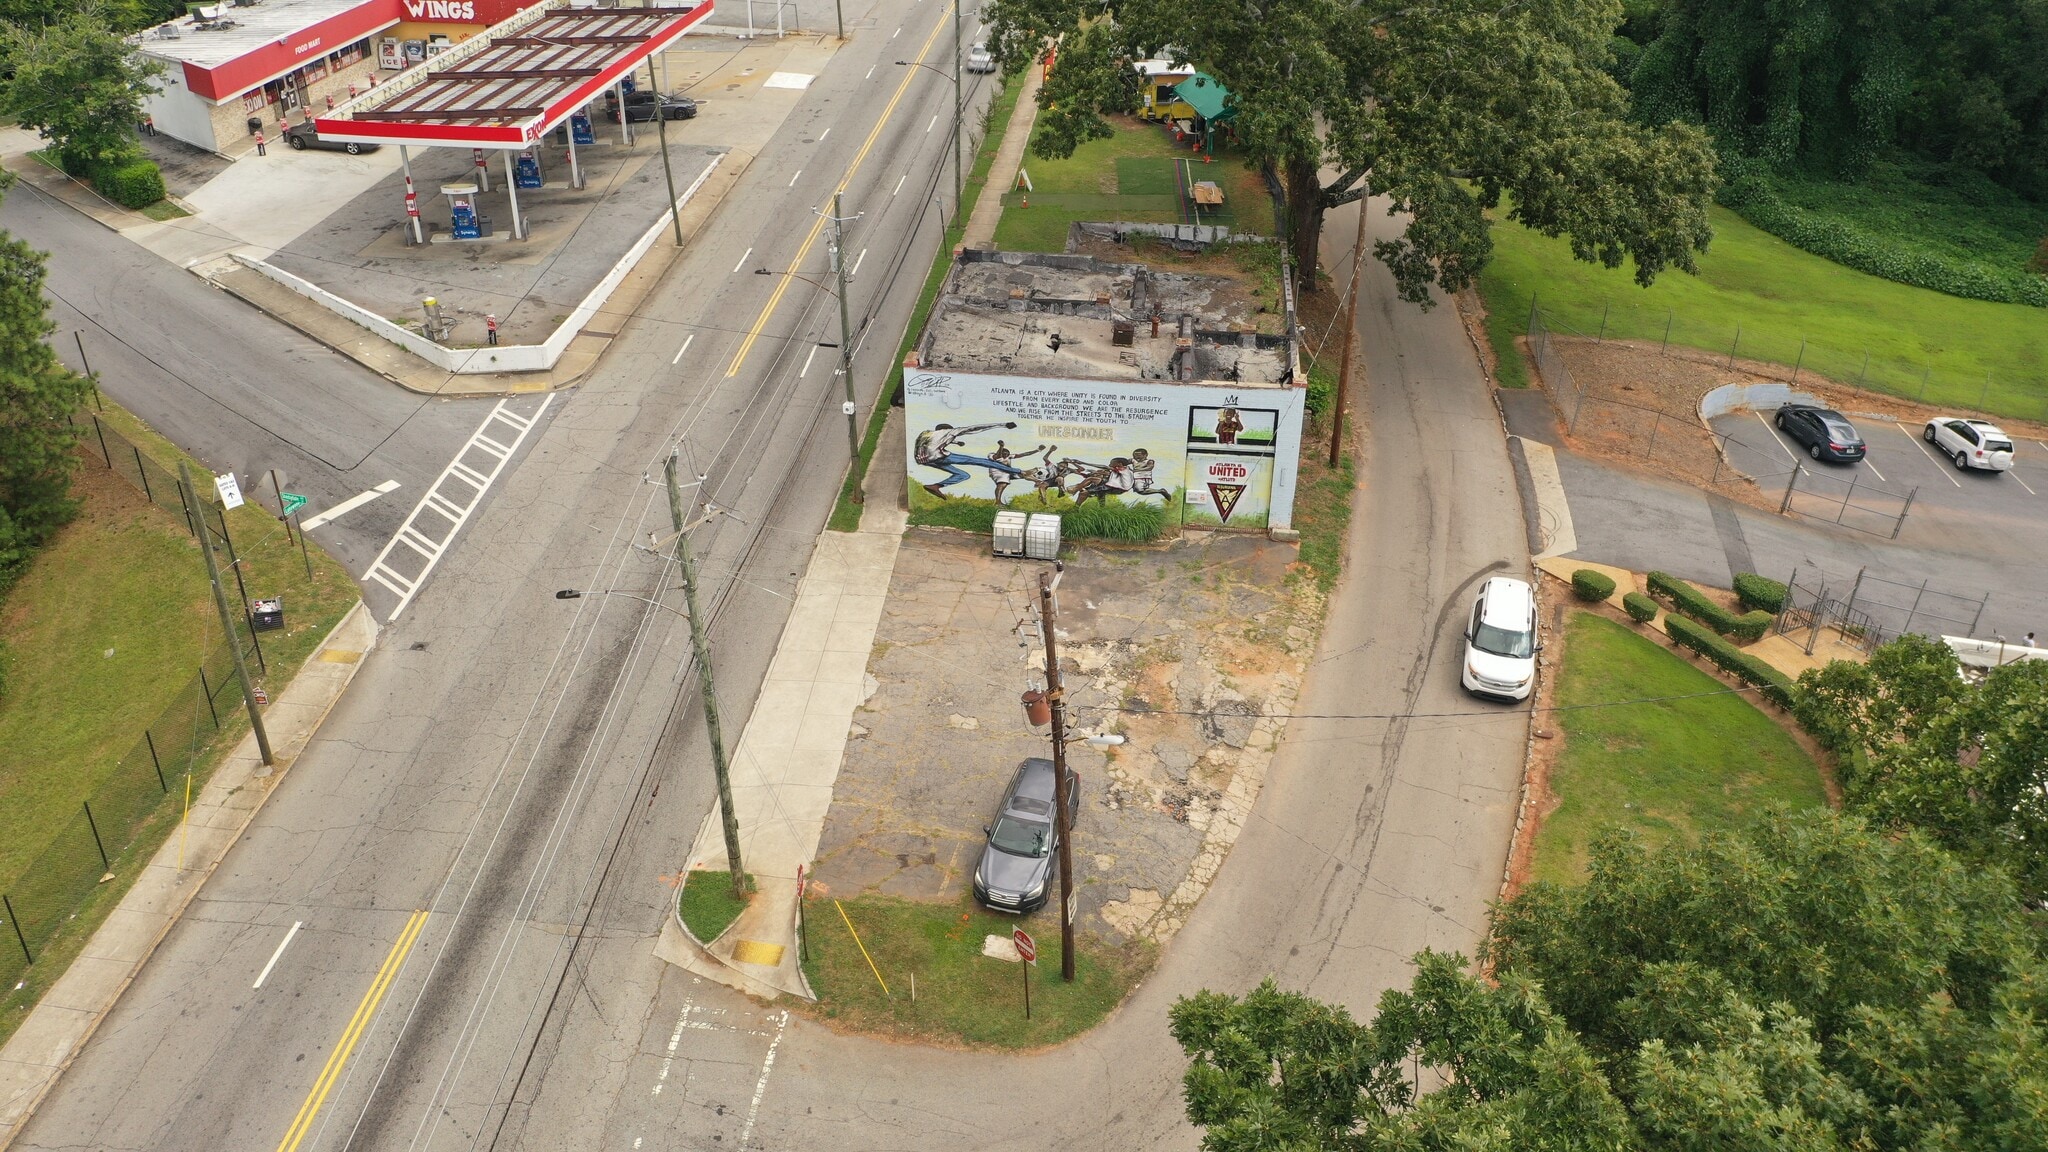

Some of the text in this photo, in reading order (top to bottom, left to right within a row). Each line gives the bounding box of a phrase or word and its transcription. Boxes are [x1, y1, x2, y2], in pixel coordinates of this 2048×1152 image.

[403, 0, 475, 19] WINGS
[295, 37, 321, 55] FOOD MART
[526, 116, 547, 141] EXXON
[1076, 410, 1101, 418] STREETS
[1126, 407, 1168, 415] RESURGENCE
[1209, 466, 1246, 477] UNITED
